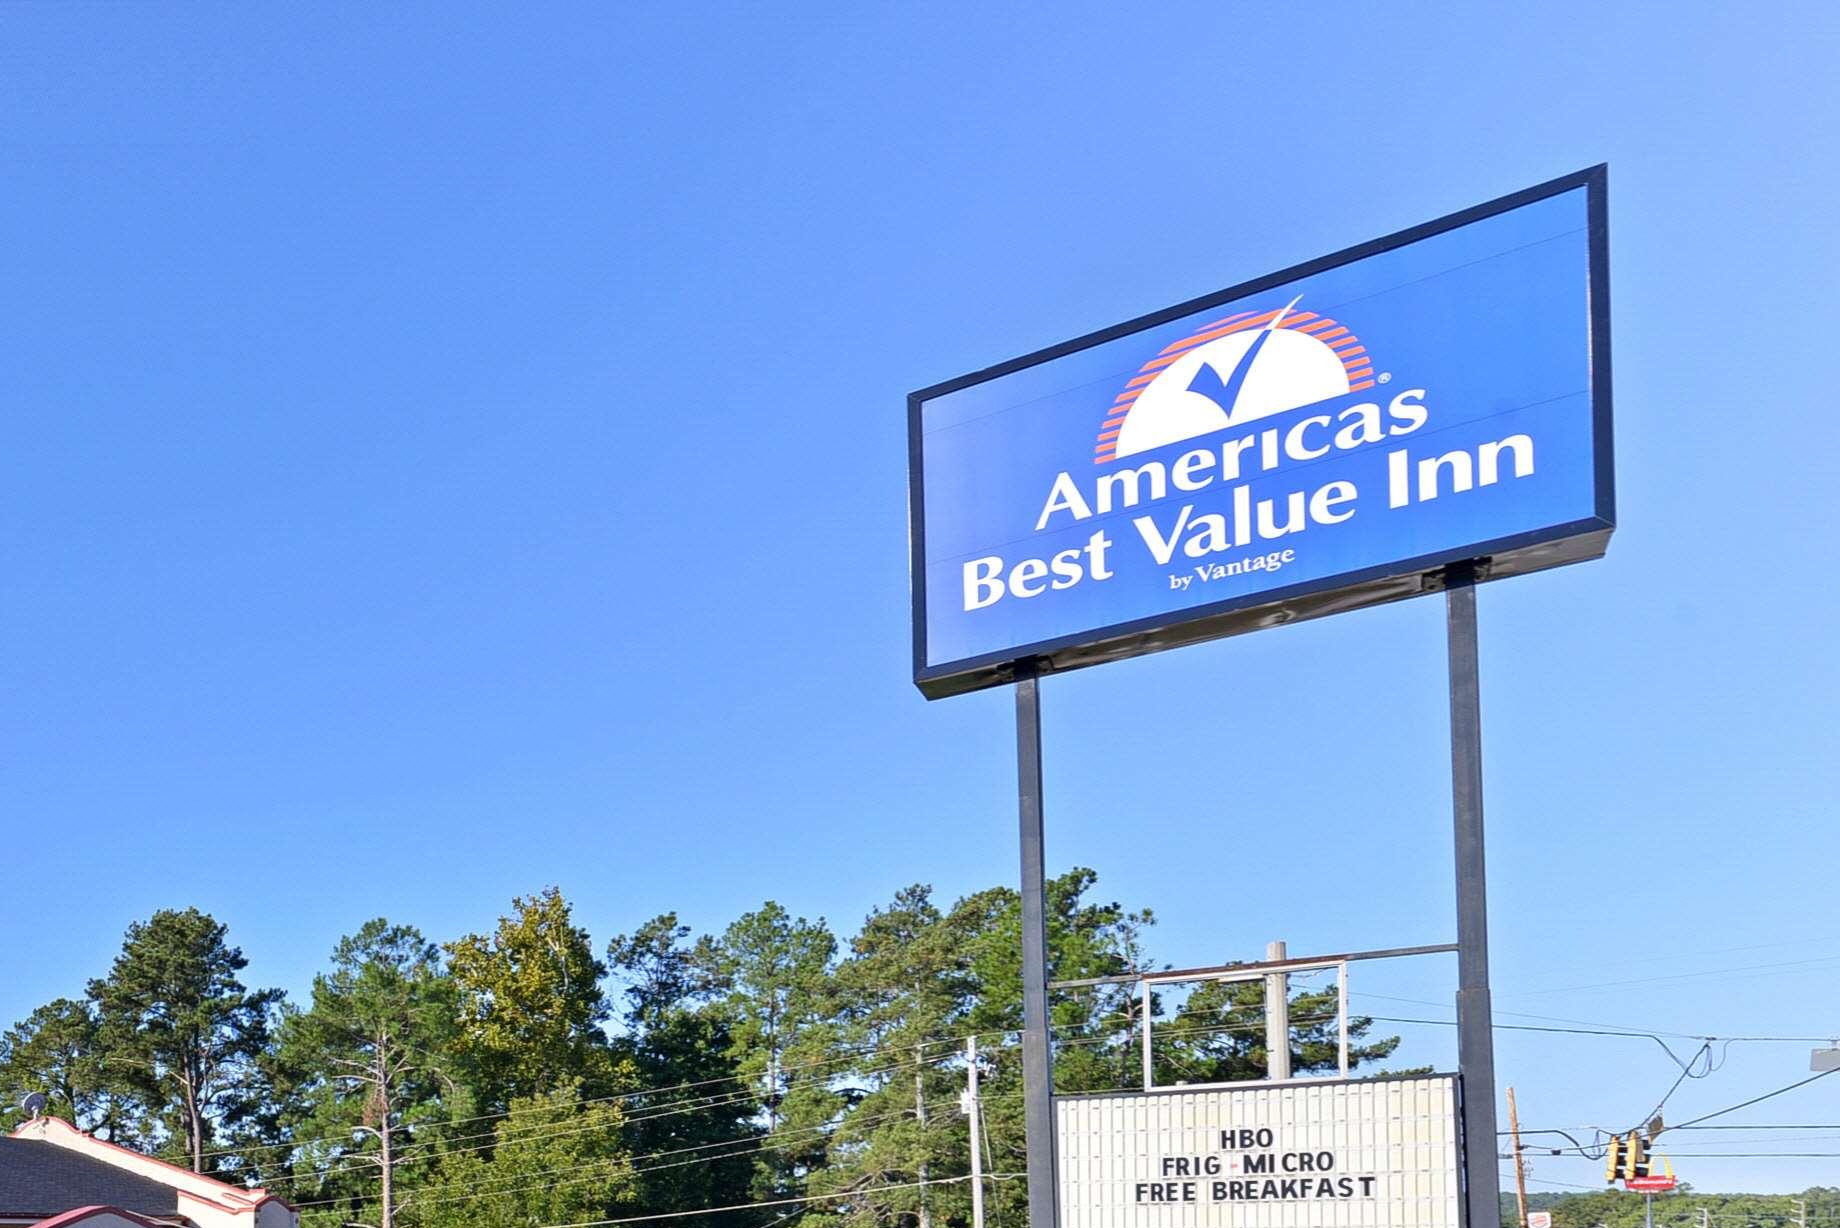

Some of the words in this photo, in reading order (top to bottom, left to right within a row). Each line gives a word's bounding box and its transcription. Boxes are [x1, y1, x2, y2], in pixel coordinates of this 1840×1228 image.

[1035, 387, 1428, 532] Americas
[963, 530, 1114, 612] Best
[1133, 480, 1359, 566] Value
[1388, 433, 1535, 509] Inn
[1169, 570, 1193, 591] by
[1195, 549, 1296, 583] Vantage
[1221, 1128, 1273, 1150] HBO
[1162, 1155, 1221, 1177] FRIG
[1243, 1151, 1334, 1174] MICRO
[1136, 1181, 1196, 1202] FREE
[1212, 1176, 1376, 1201] BREAKFAST
